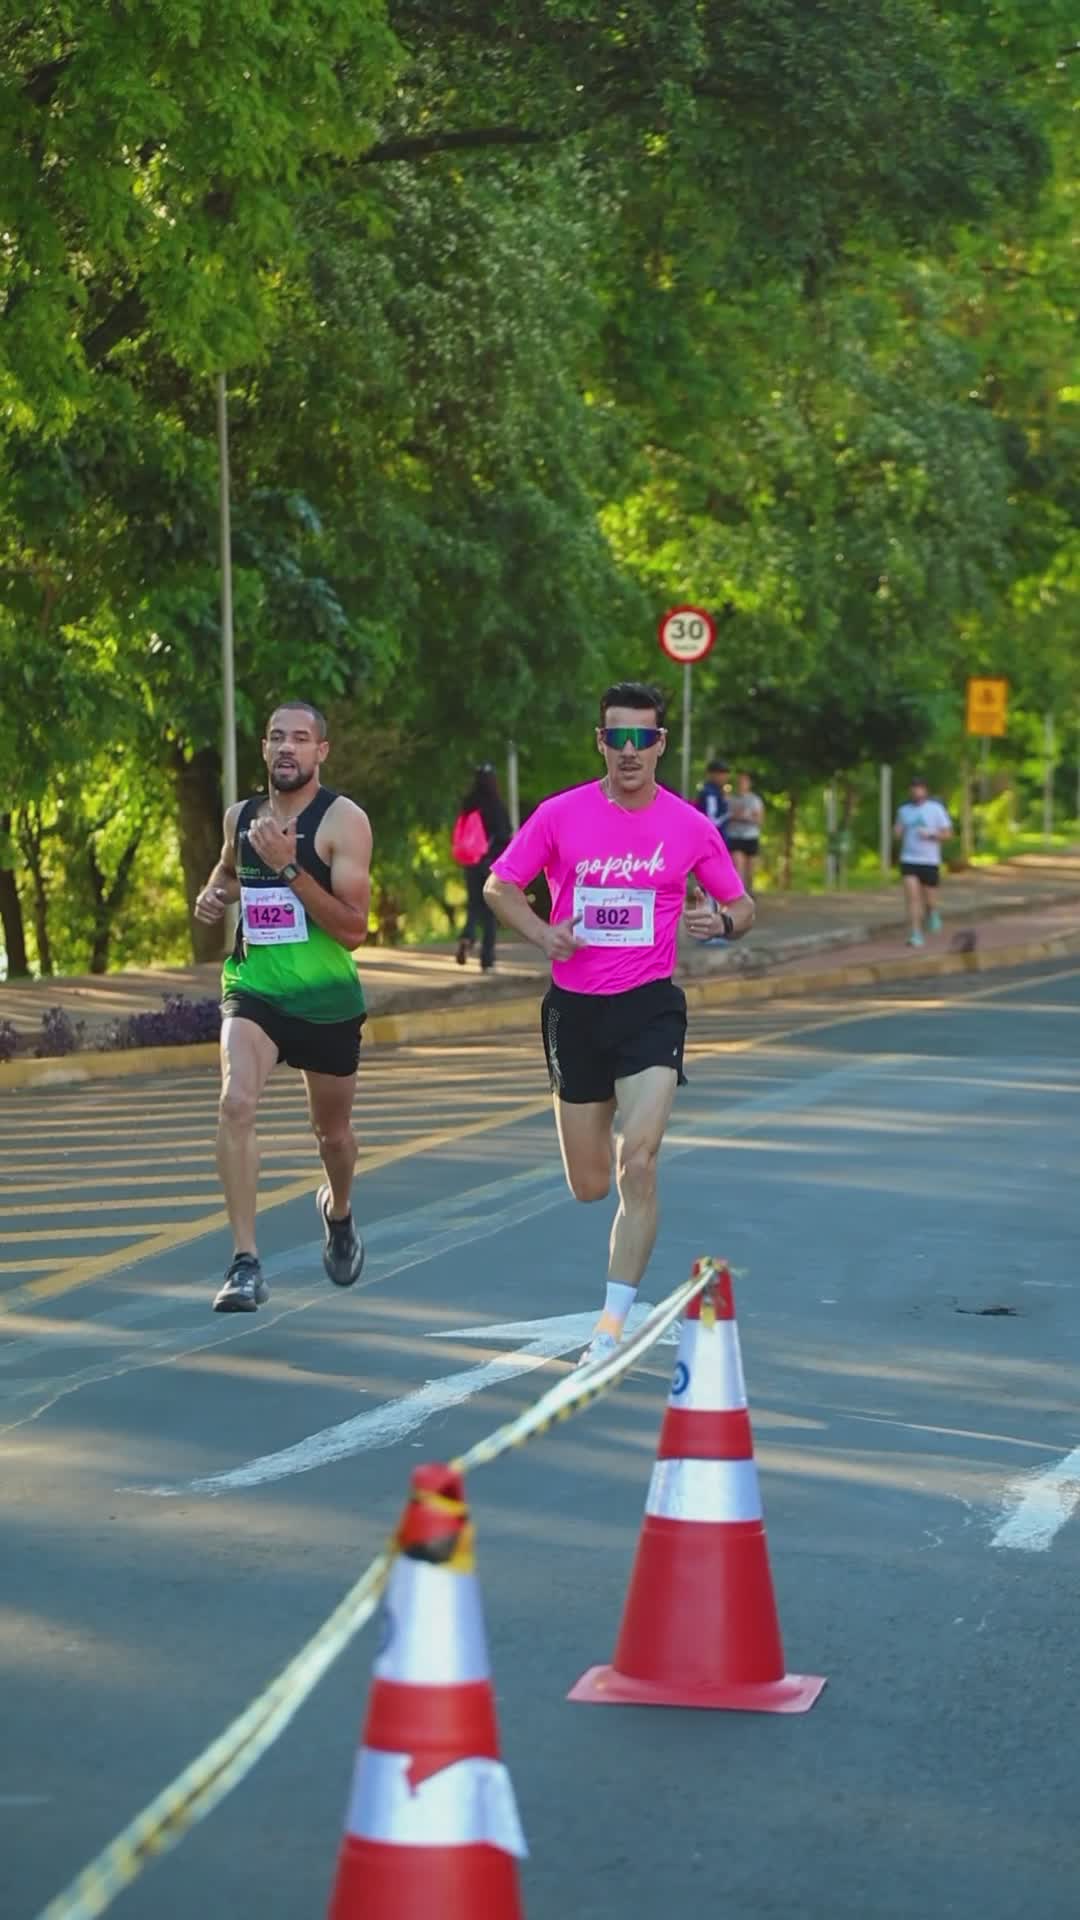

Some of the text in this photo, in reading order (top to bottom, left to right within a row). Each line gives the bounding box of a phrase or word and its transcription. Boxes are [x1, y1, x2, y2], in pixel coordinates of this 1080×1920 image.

[670, 619, 704, 640] 30
[575, 841, 665, 886] gopink
[252, 907, 281, 923] 142
[596, 908, 630, 925] 802
